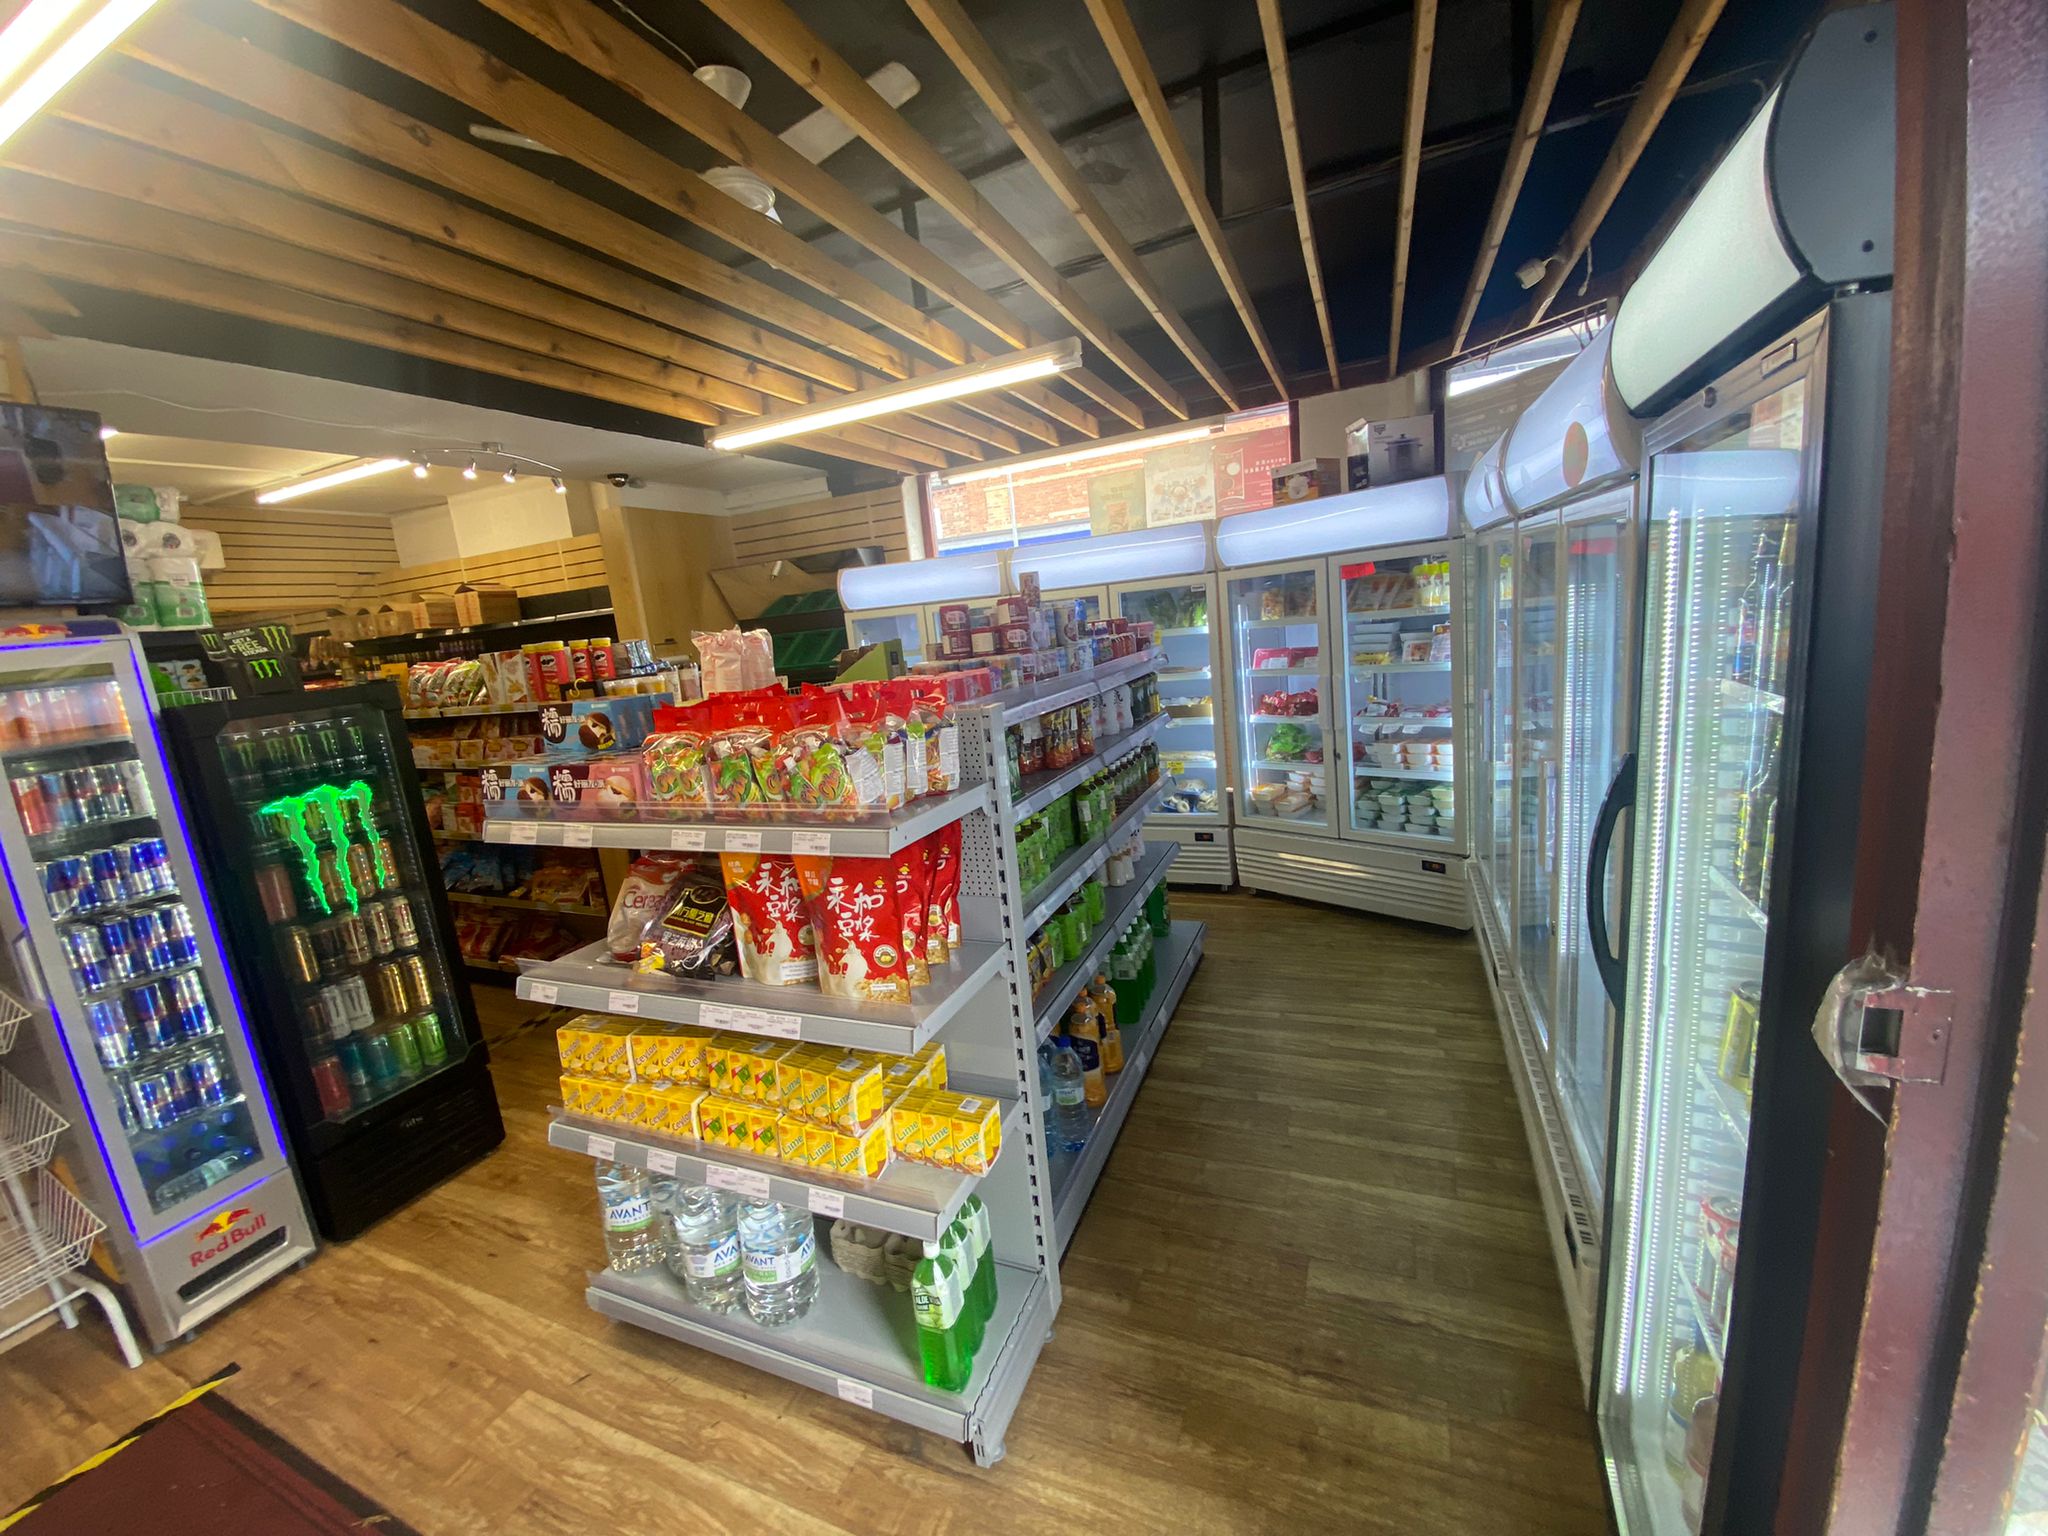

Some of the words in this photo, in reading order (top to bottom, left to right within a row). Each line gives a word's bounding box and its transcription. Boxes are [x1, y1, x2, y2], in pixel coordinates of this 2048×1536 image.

[229, 640, 263, 654] FREE
[542, 707, 562, 738] 糯
[482, 769, 501, 801] 糯
[552, 769, 577, 804] 糯
[826, 877, 884, 917] 永和
[836, 912, 881, 942] 豆浆
[635, 1043, 658, 1065] Ceylon
[662, 1044, 685, 1067] Ceylon
[688, 1048, 706, 1068] Ceylo
[781, 1077, 801, 1097] Lime
[805, 1084, 827, 1104] Lime
[831, 1094, 851, 1112] Lim
[896, 1120, 919, 1141] Lime
[925, 1126, 949, 1148] Lime
[782, 1135, 804, 1156] Lime
[808, 1141, 832, 1162] Lime
[955, 1132, 980, 1154] Lime
[836, 1146, 860, 1168] Lime
[610, 1200, 651, 1219] AVANT
[190, 1237, 228, 1267] Red
[231, 1215, 266, 1243] Bull
[714, 1245, 738, 1263] AVA
[746, 1254, 775, 1266] AVANT
